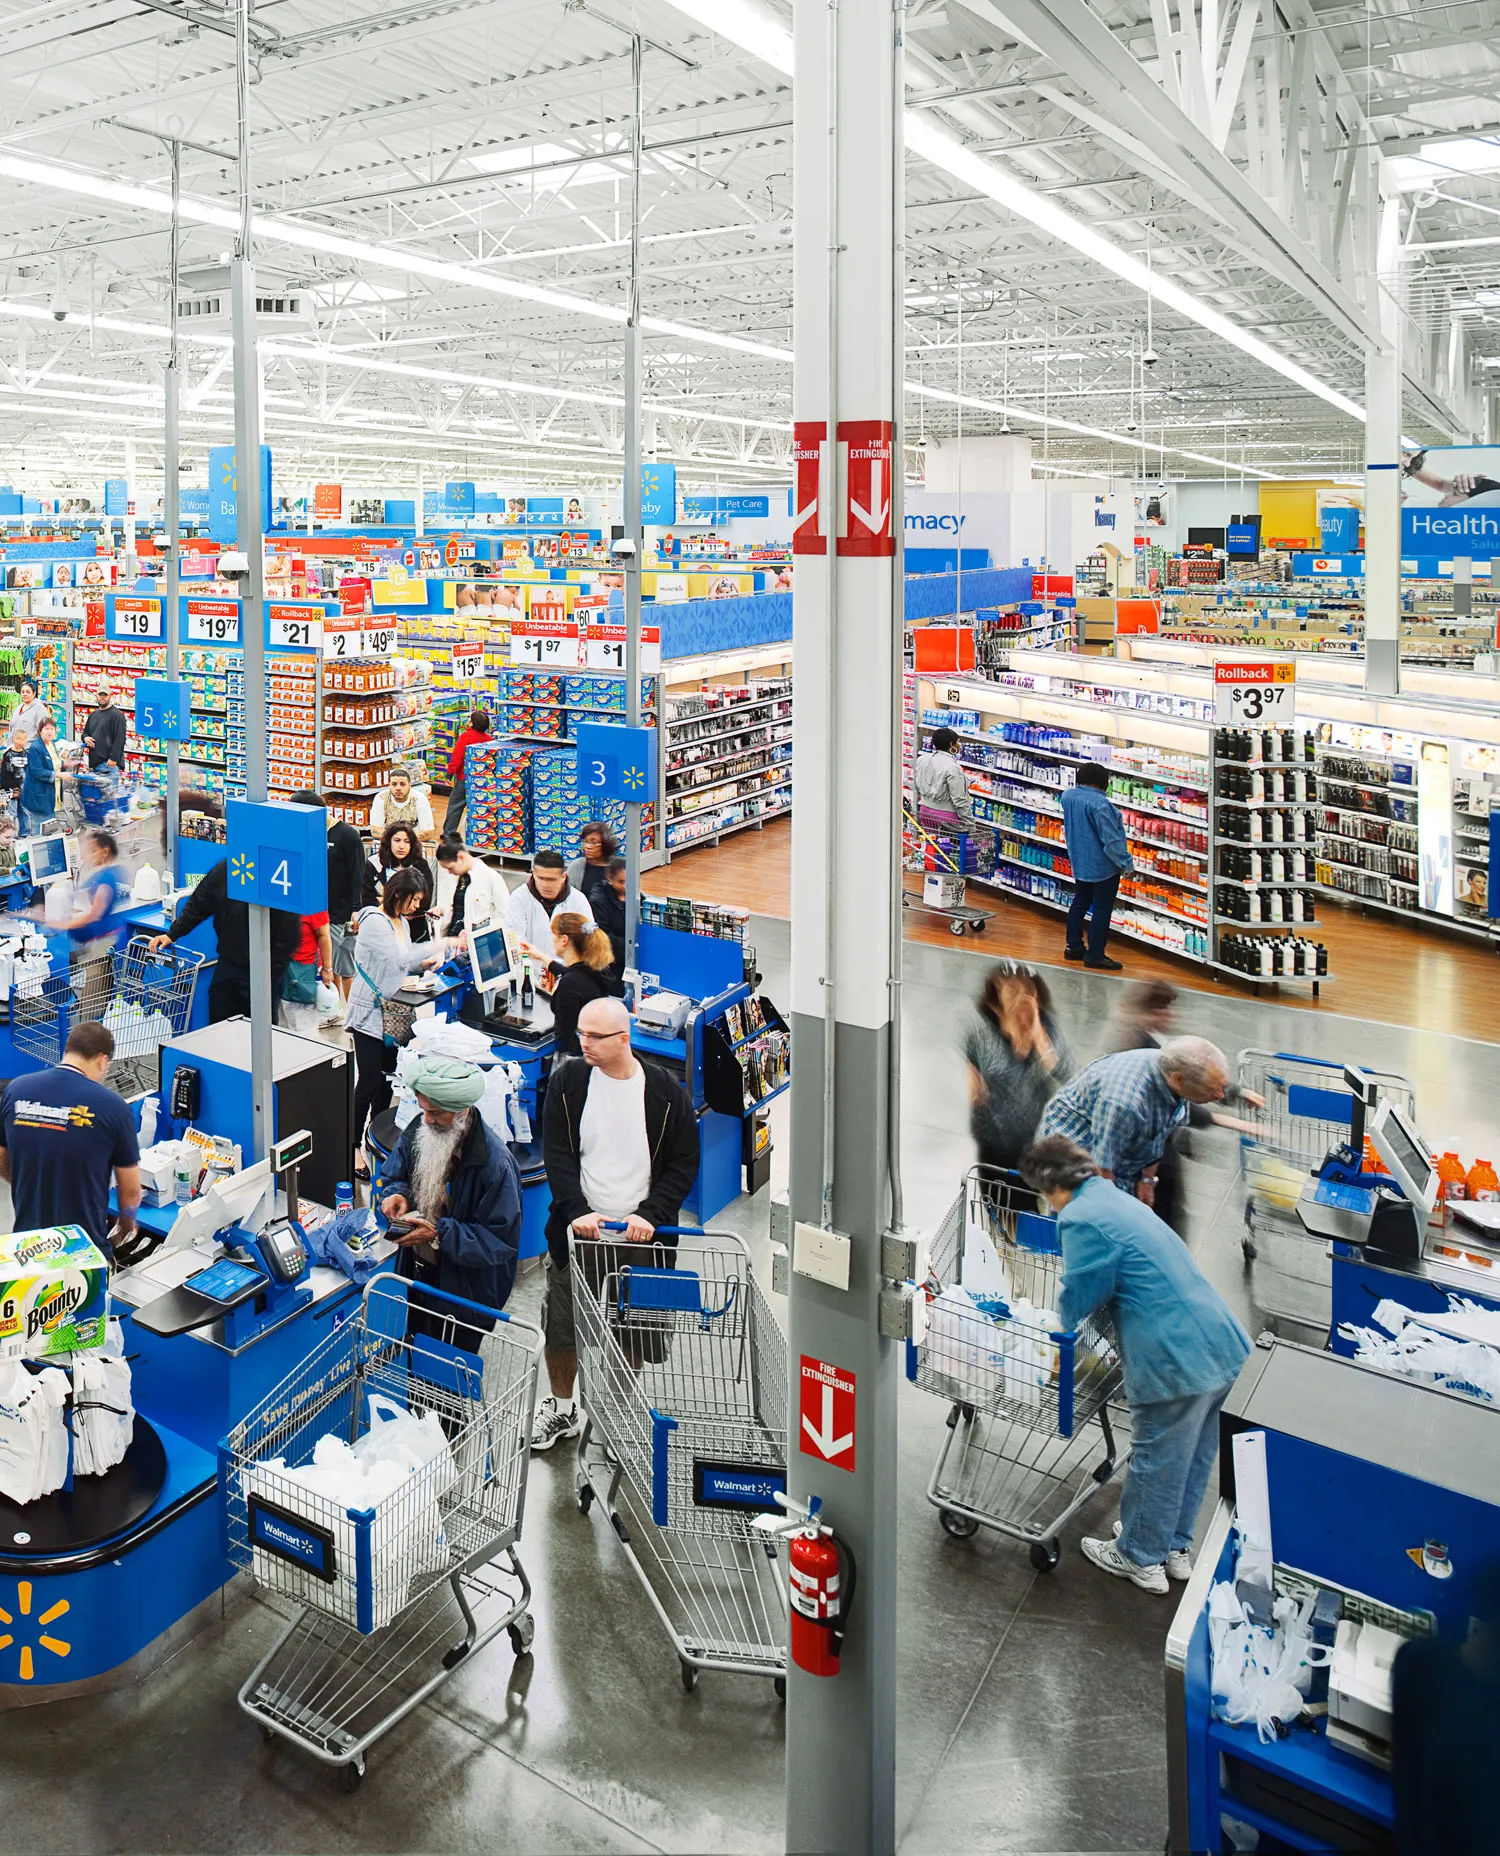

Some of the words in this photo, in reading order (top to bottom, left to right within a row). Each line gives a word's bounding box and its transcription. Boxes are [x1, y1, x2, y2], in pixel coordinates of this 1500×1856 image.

[794, 450, 819, 460] UISHER
[641, 503, 661, 515] aby
[726, 499, 739, 508] Pet
[741, 500, 763, 508] Care
[904, 514, 966, 536] macy
[1322, 517, 1343, 537] eauty
[1412, 514, 1498, 535] Health
[1471, 540, 1499, 549] Salu
[198, 604, 230, 612] Unbeatable
[281, 610, 310, 619] Rollback
[124, 614, 149, 633] $19
[525, 623, 569, 632] Unbeatable
[602, 627, 648, 637] Unbeale
[282, 623, 310, 645] $21
[333, 634, 346, 656] $2
[1217, 668, 1269, 679] Rollback
[143, 707, 154, 727] 5
[591, 760, 606, 786] 3
[270, 859, 292, 896] 4
[3, 1300, 14, 1319] 6
[25, 1286, 82, 1344] Bounty
[0, 1318, 18, 1326] SUPER
[819, 1362, 837, 1377] FIRE
[801, 1366, 855, 1394] EXTINGUISHER
[714, 1479, 756, 1493] Walmart
[263, 1521, 300, 1547] Walmart
